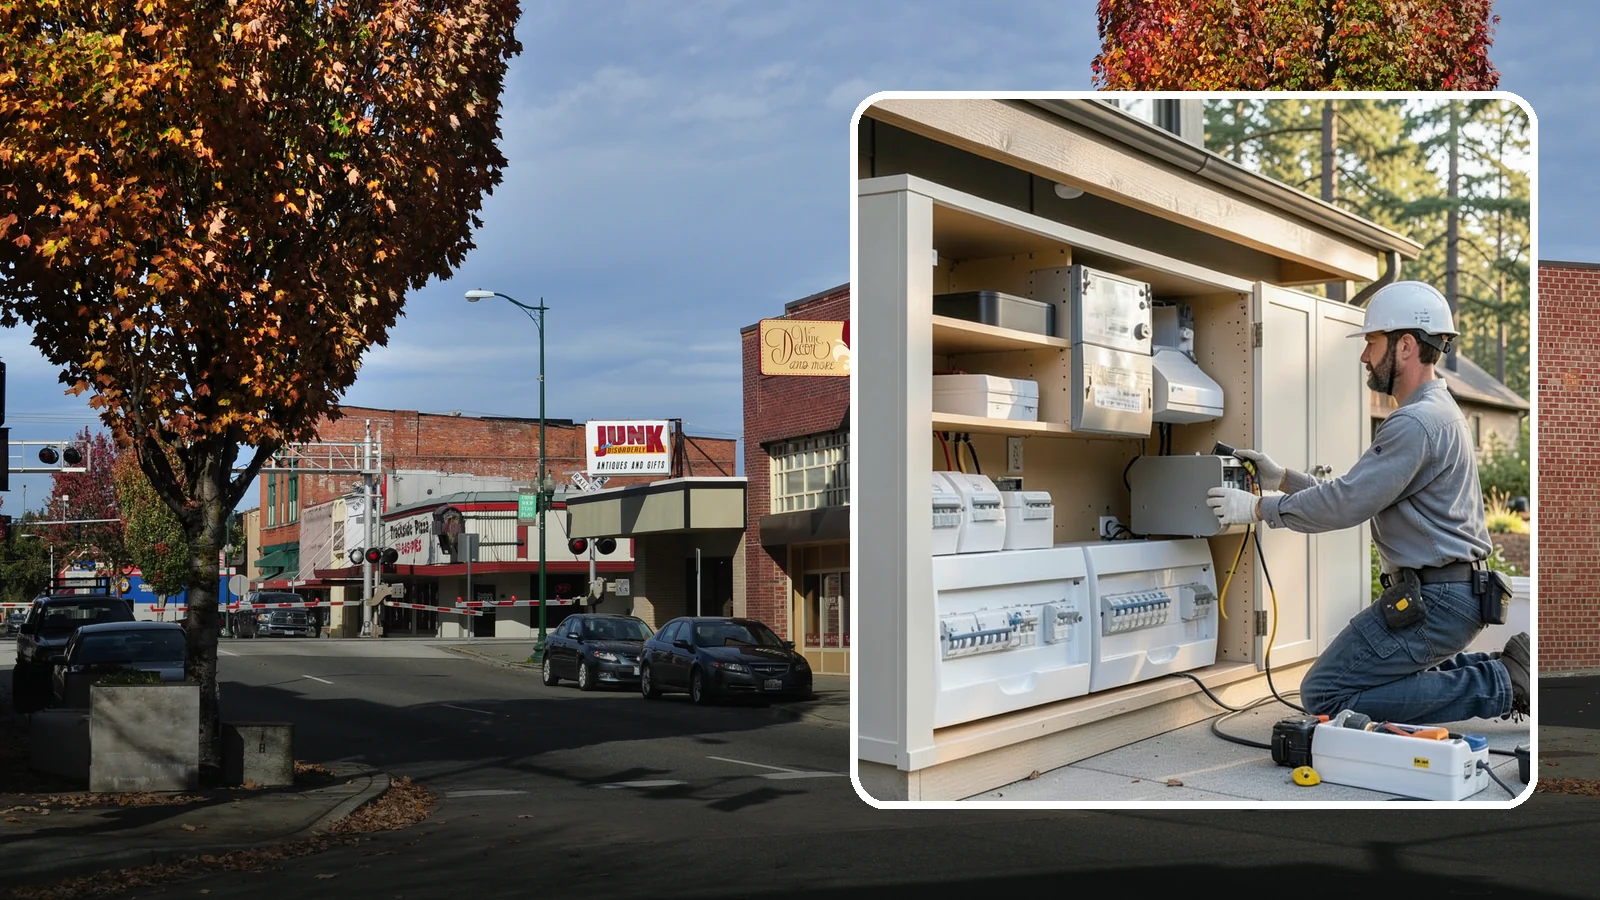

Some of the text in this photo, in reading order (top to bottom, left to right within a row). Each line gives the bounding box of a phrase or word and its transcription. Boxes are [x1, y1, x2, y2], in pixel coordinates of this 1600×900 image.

[596, 425, 665, 457] JUNK
[607, 446, 646, 454] DISORDERLY
[597, 460, 665, 470] ANTIQUES AND GIFTS
[590, 476, 608, 492] SING
[352, 498, 365, 511] CRO
[414, 519, 429, 535] Pizza
